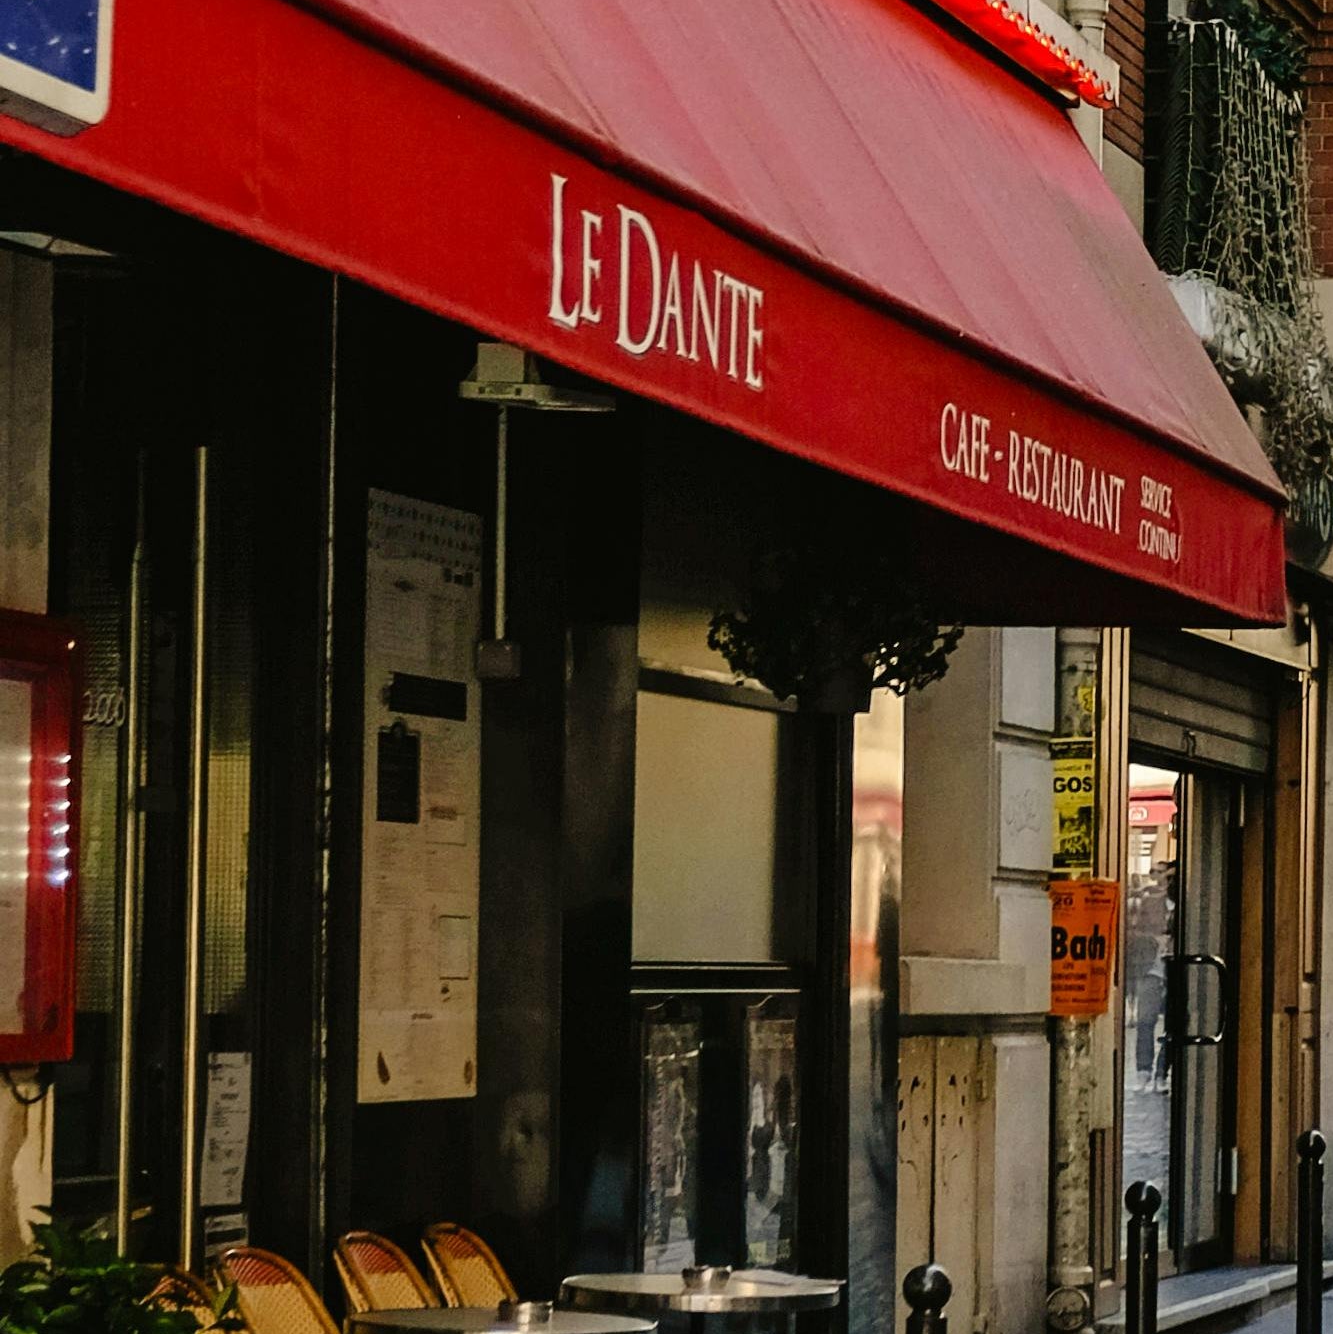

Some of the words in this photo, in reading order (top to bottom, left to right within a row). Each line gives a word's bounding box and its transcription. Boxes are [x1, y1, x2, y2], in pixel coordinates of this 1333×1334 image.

[548, 173, 602, 329] LE
[615, 203, 764, 390] DANTE
[940, 403, 991, 484] CAFE
[1007, 430, 1125, 535] RESTAURANT
[1051, 924, 1106, 960] Bach
